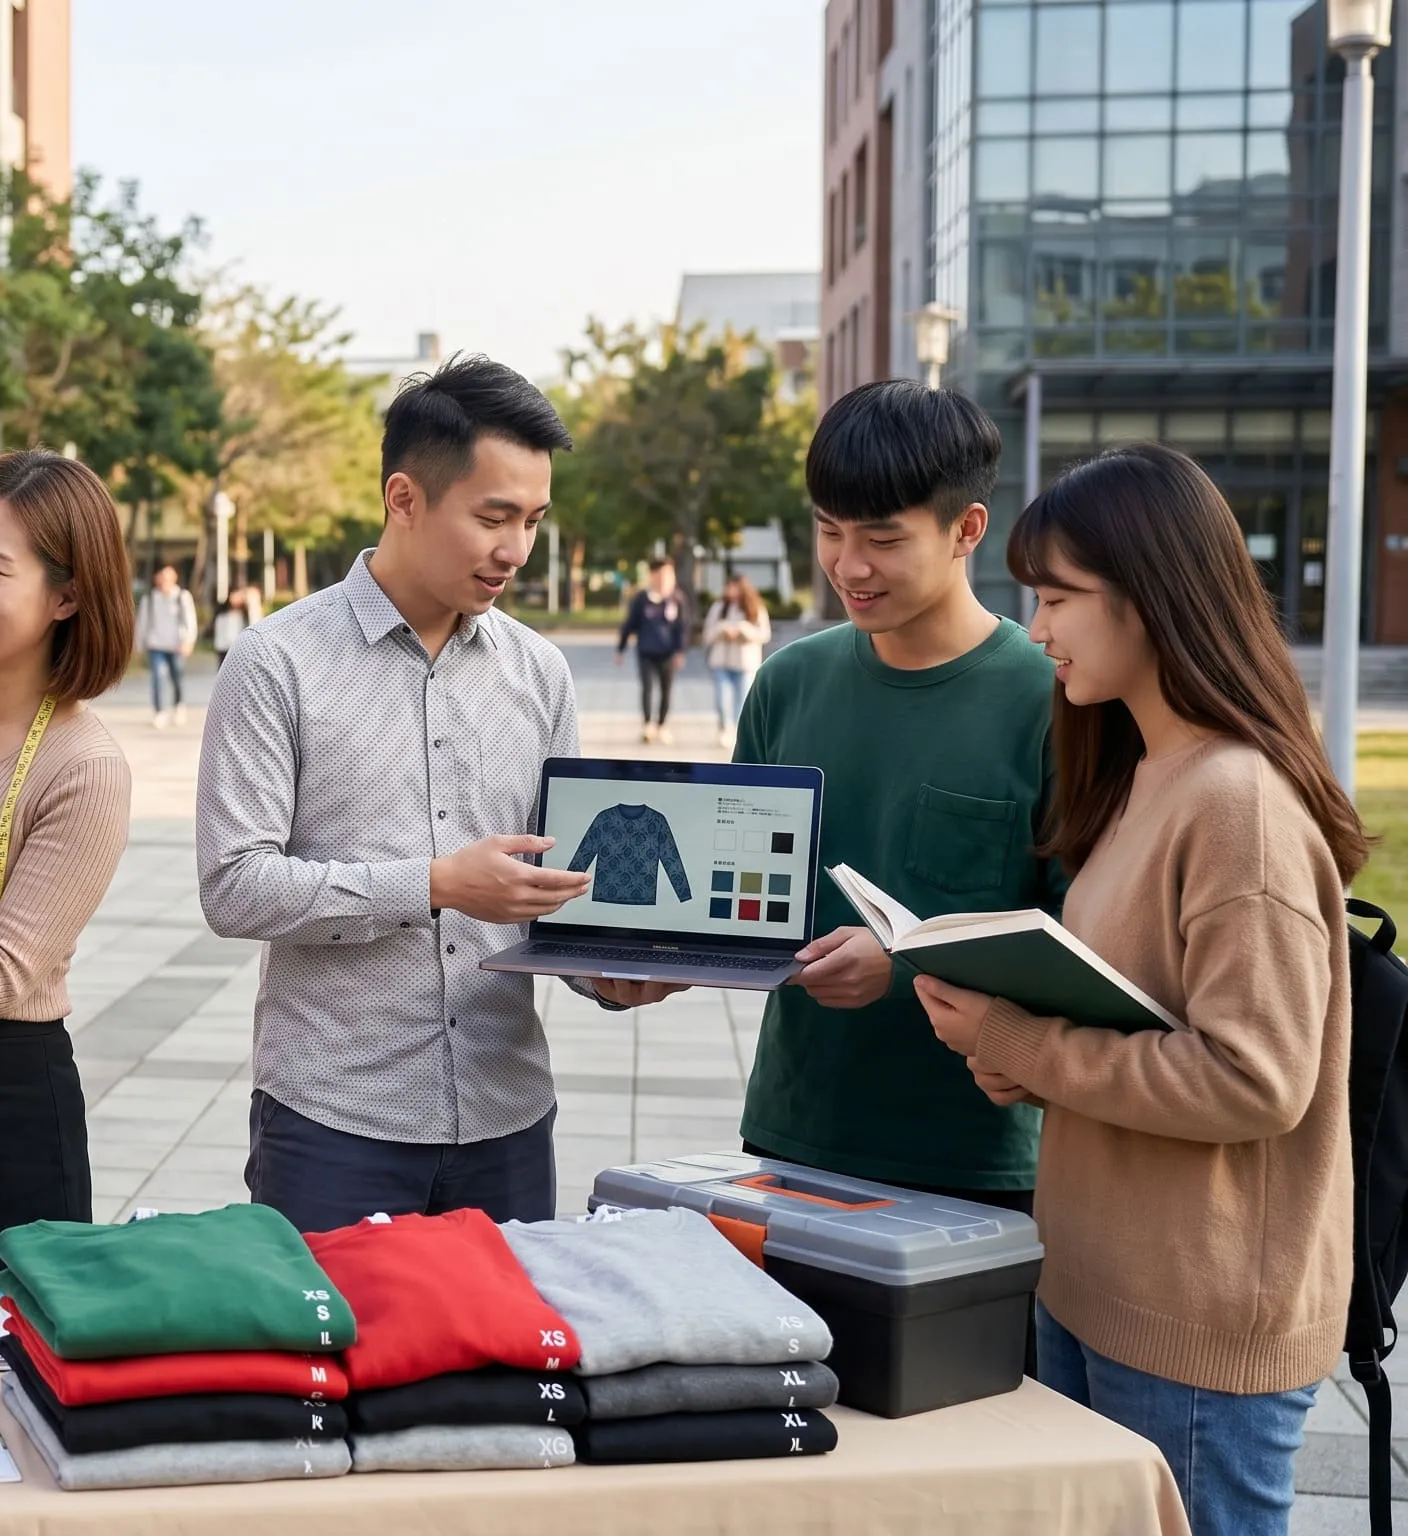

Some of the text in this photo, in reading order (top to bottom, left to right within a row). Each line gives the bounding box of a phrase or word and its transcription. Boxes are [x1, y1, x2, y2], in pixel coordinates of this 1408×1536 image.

[302, 1290, 330, 1301] XS
[316, 1304, 330, 1321] S
[776, 1316, 804, 1330] XS
[539, 1330, 567, 1347] XS
[788, 1338, 800, 1354] S
[545, 1357, 560, 1369] M
[311, 1366, 327, 1383] M
[779, 1370, 806, 1386] XL
[538, 1382, 566, 1400] XS
[547, 1408, 556, 1422] L
[781, 1413, 808, 1428] XL
[538, 1436, 568, 1456] XG
